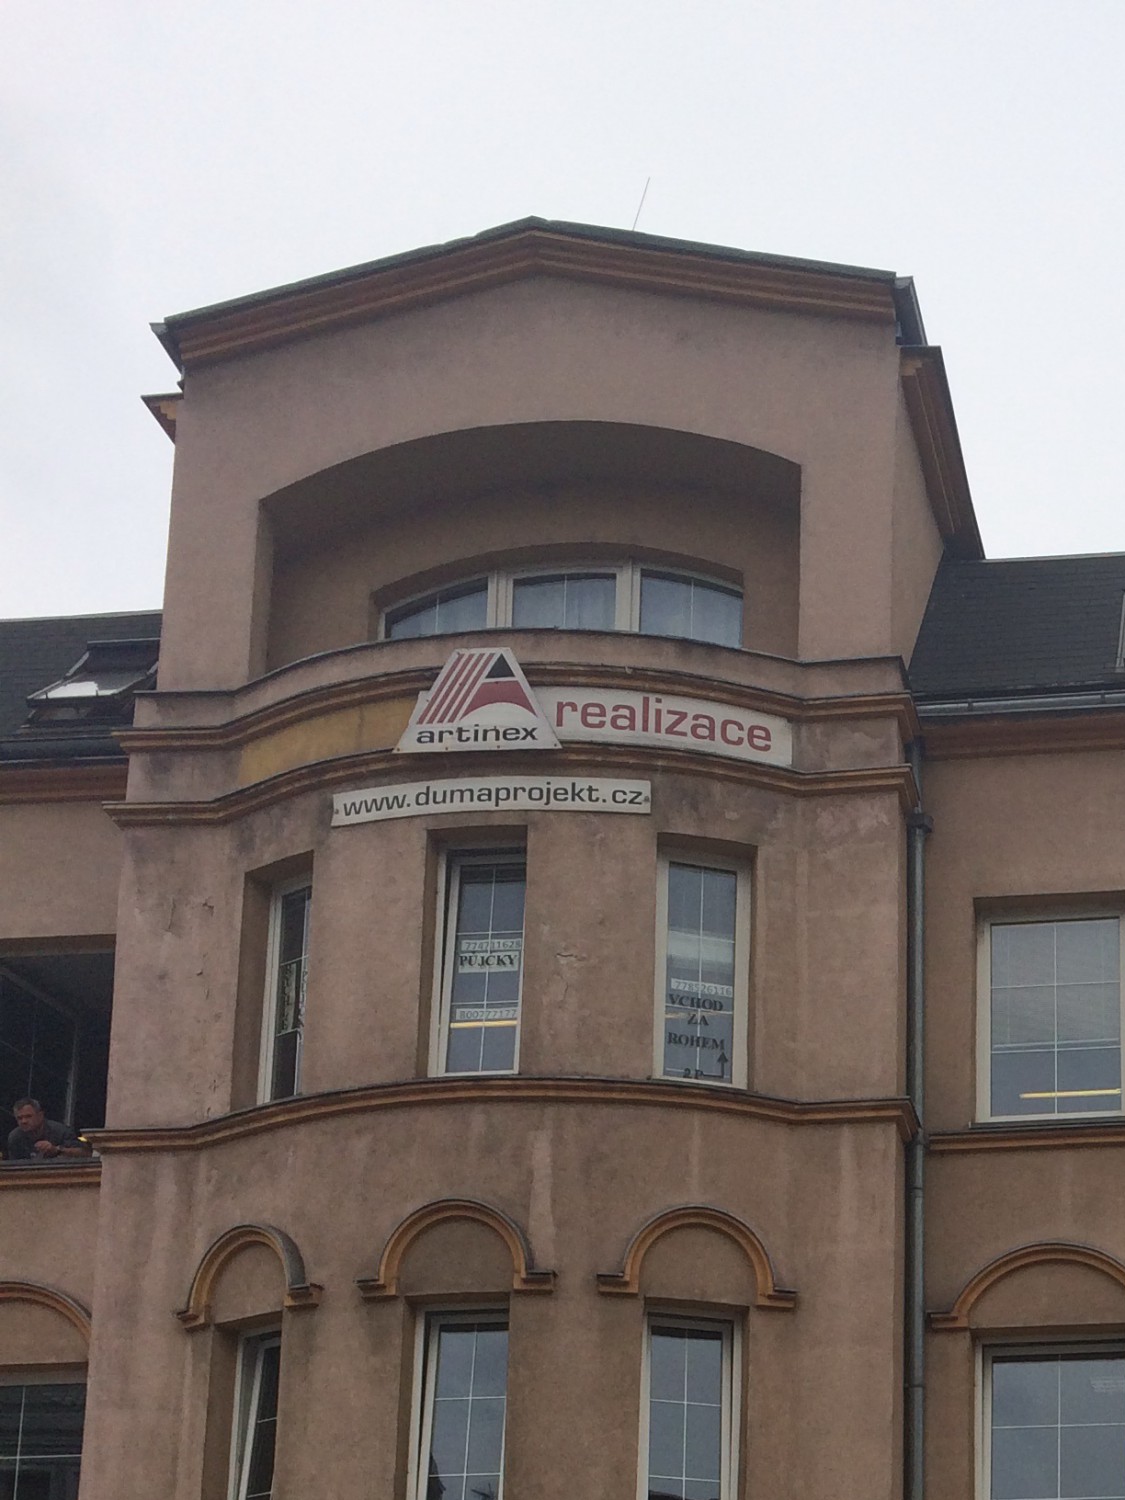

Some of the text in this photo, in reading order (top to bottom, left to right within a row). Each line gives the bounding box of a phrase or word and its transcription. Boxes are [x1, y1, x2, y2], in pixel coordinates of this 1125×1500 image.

[416, 724, 538, 744] artinex
[556, 696, 772, 751] realizace
[343, 781, 643, 816] www.dumaprojekt.cz
[668, 993, 723, 1011] VCHOD
